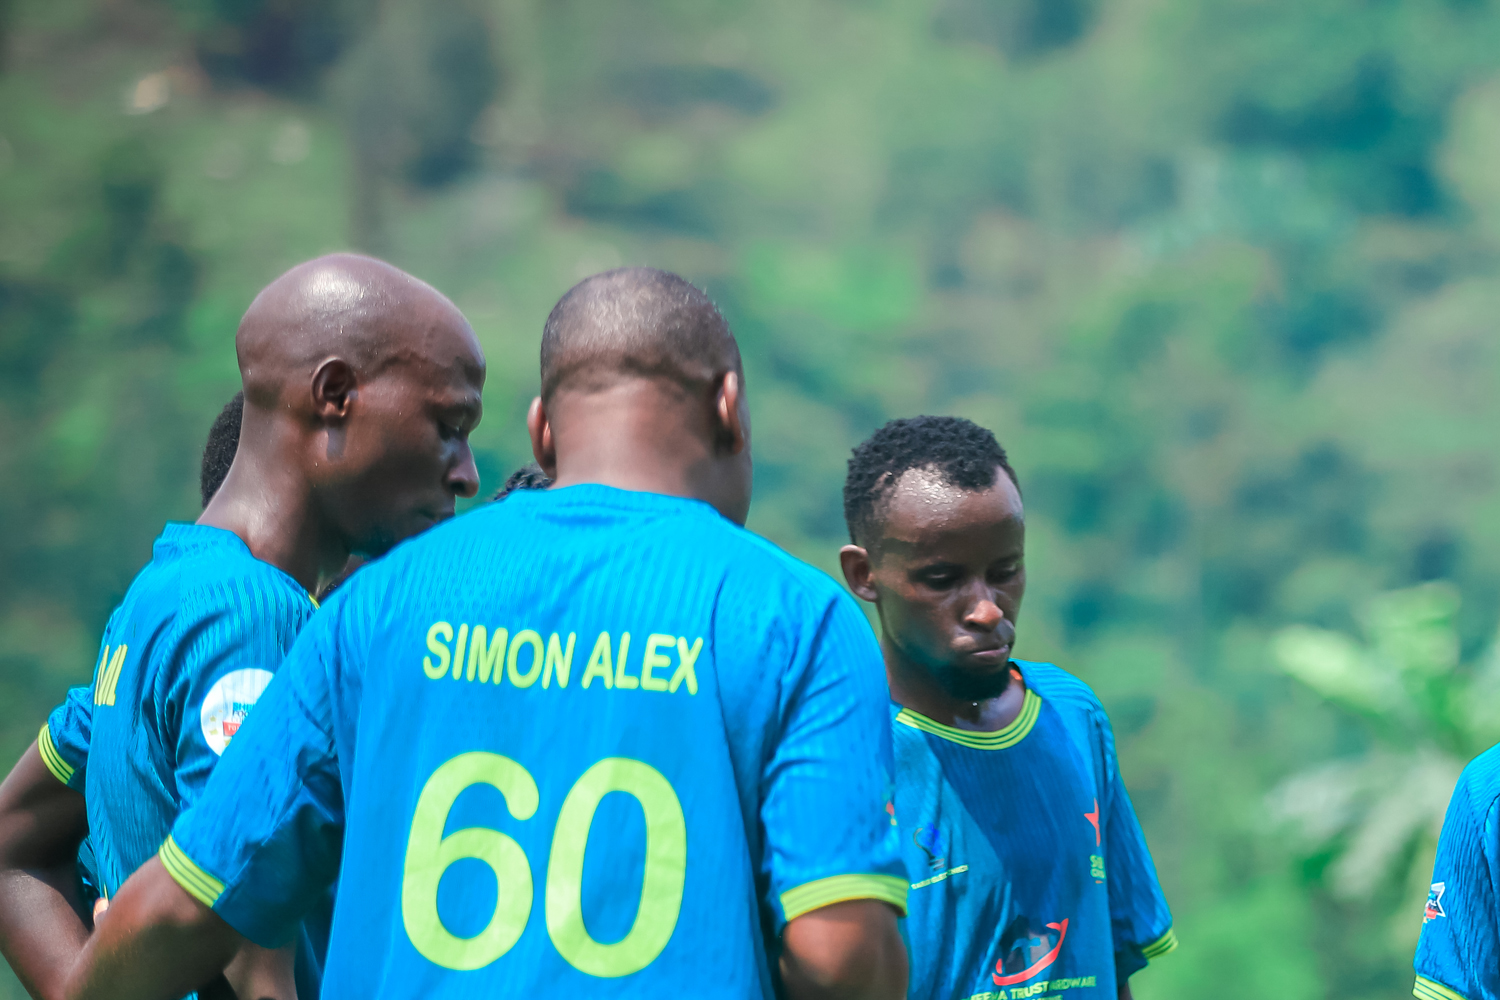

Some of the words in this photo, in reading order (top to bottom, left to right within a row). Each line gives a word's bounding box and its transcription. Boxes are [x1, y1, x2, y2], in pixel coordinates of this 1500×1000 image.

[423, 621, 577, 690] SIMON
[582, 631, 704, 696] ALEX
[401, 751, 687, 978] 60
[1009, 981, 1050, 1000] TRUST
